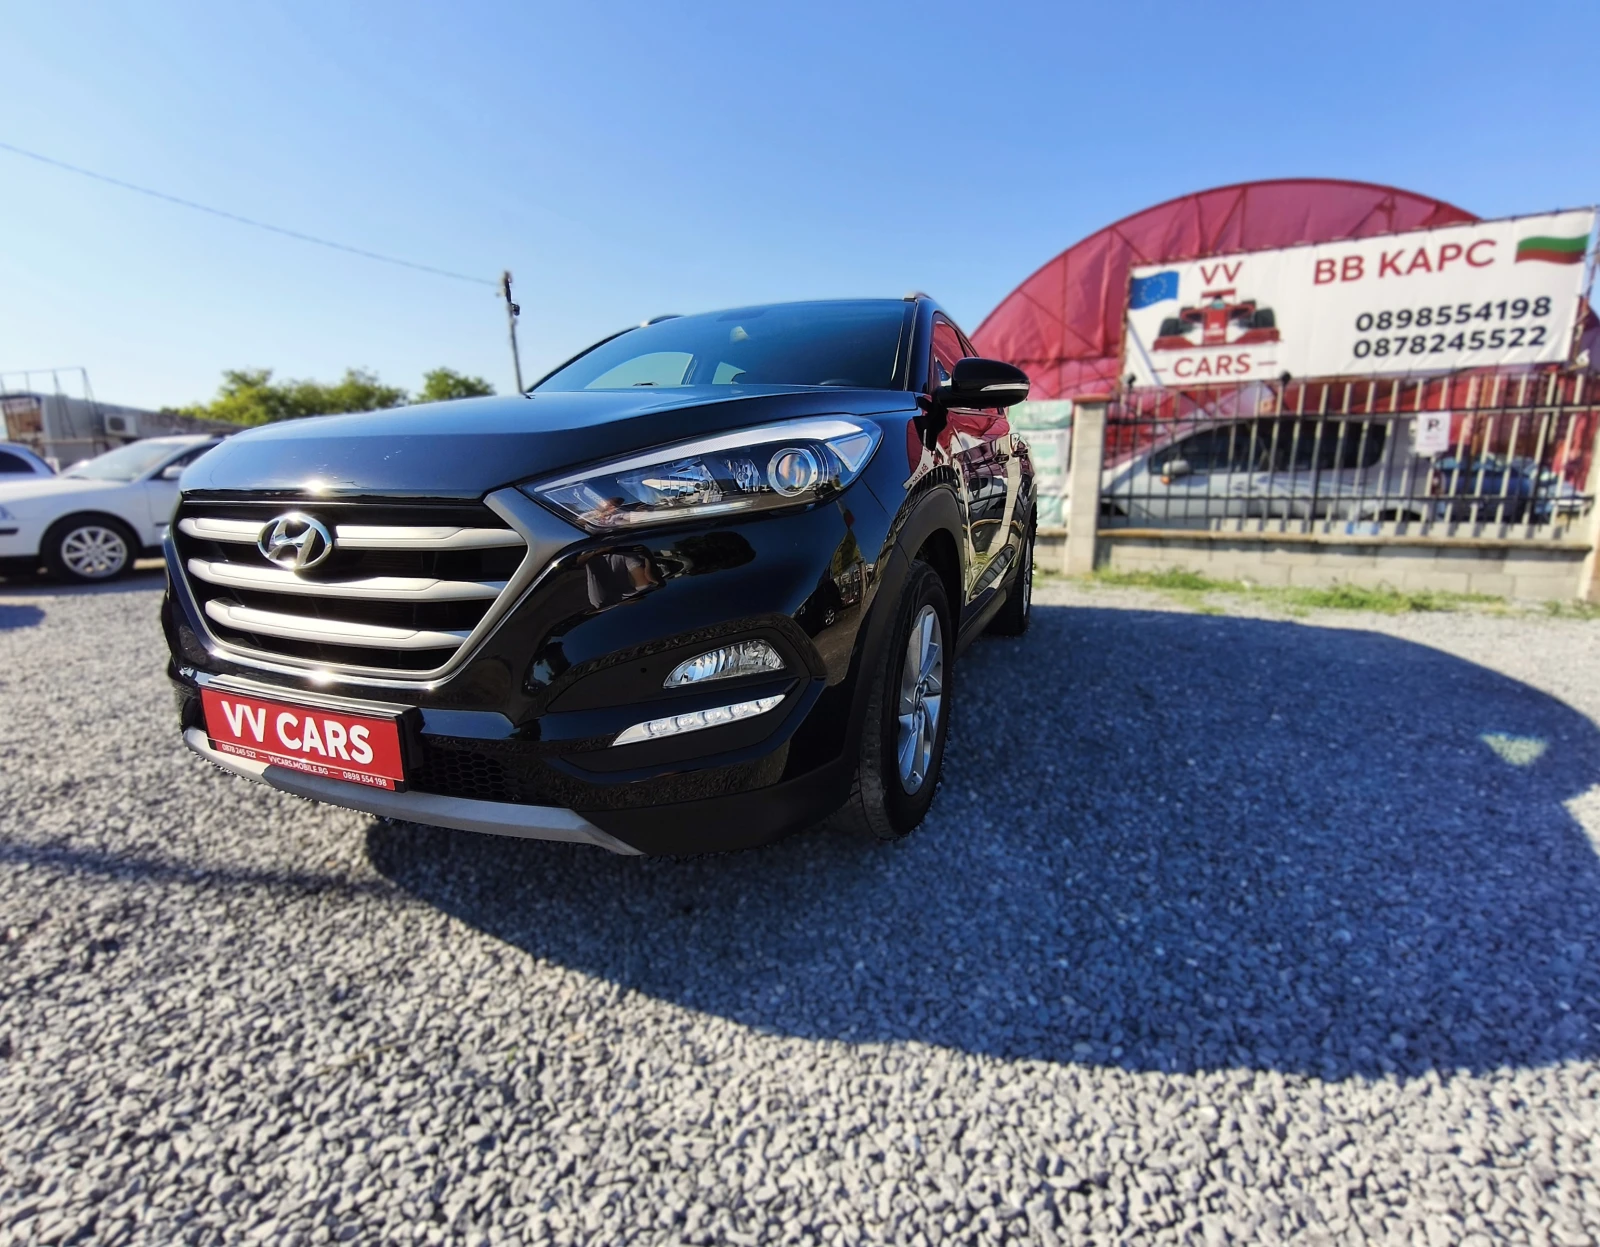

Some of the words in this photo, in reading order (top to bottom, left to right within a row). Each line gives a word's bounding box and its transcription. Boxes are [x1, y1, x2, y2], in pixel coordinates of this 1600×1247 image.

[1200, 261, 1242, 286] VV
[1313, 255, 1364, 286] ВВ
[1378, 239, 1497, 279] КАРС
[1355, 296, 1551, 332] 0898554198
[1353, 326, 1547, 359] 0878245522
[1174, 353, 1251, 378] CARS
[221, 700, 267, 743] VV
[276, 712, 373, 764] CARS
[222, 744, 235, 753] 0878
[235, 747, 246, 756] 245
[245, 749, 256, 759] 522
[268, 754, 329, 775] VVCARS.MOBILE.BG
[342, 771, 361, 781] 0898
[361, 774, 374, 784] 554
[374, 777, 387, 787] 198
